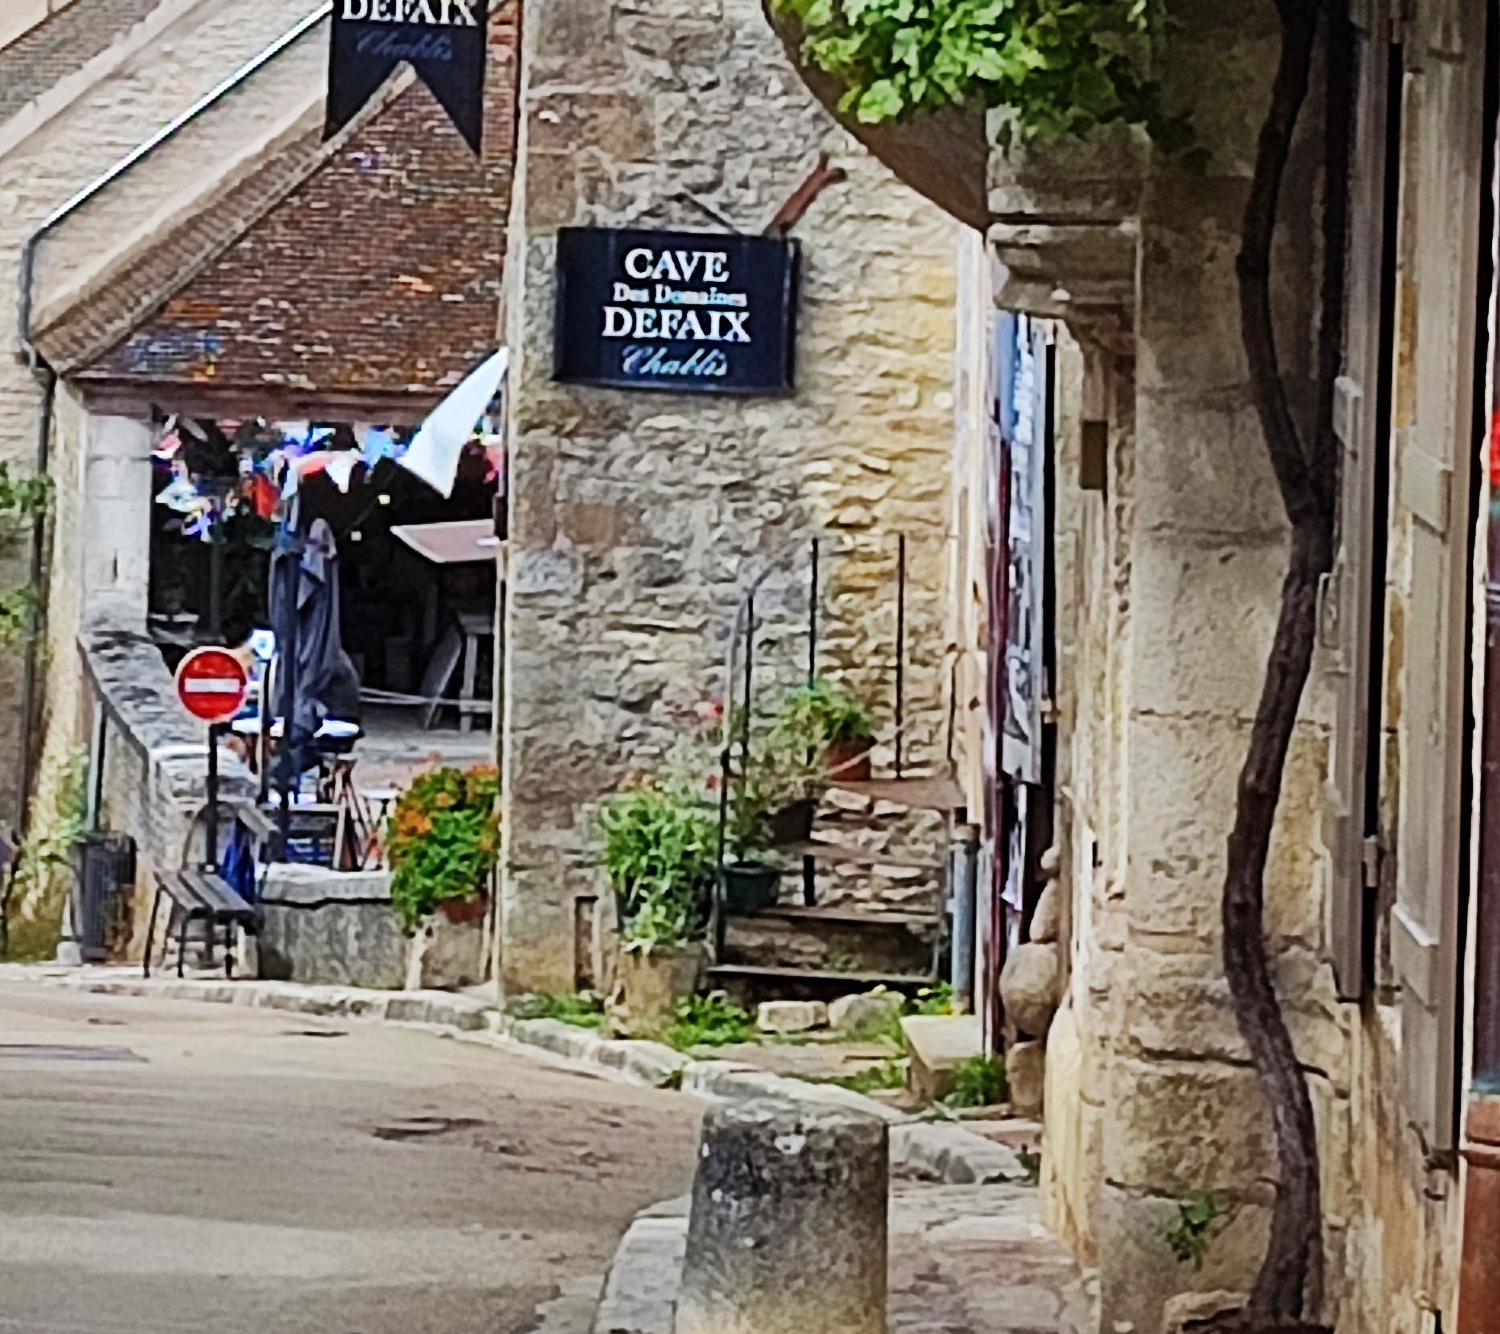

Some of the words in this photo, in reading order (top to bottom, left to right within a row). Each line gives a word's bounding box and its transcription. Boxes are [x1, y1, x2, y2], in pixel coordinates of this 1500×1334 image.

[624, 248, 730, 282] CAVE
[602, 306, 752, 342] DEFAIX
[621, 345, 728, 376] Chablis
